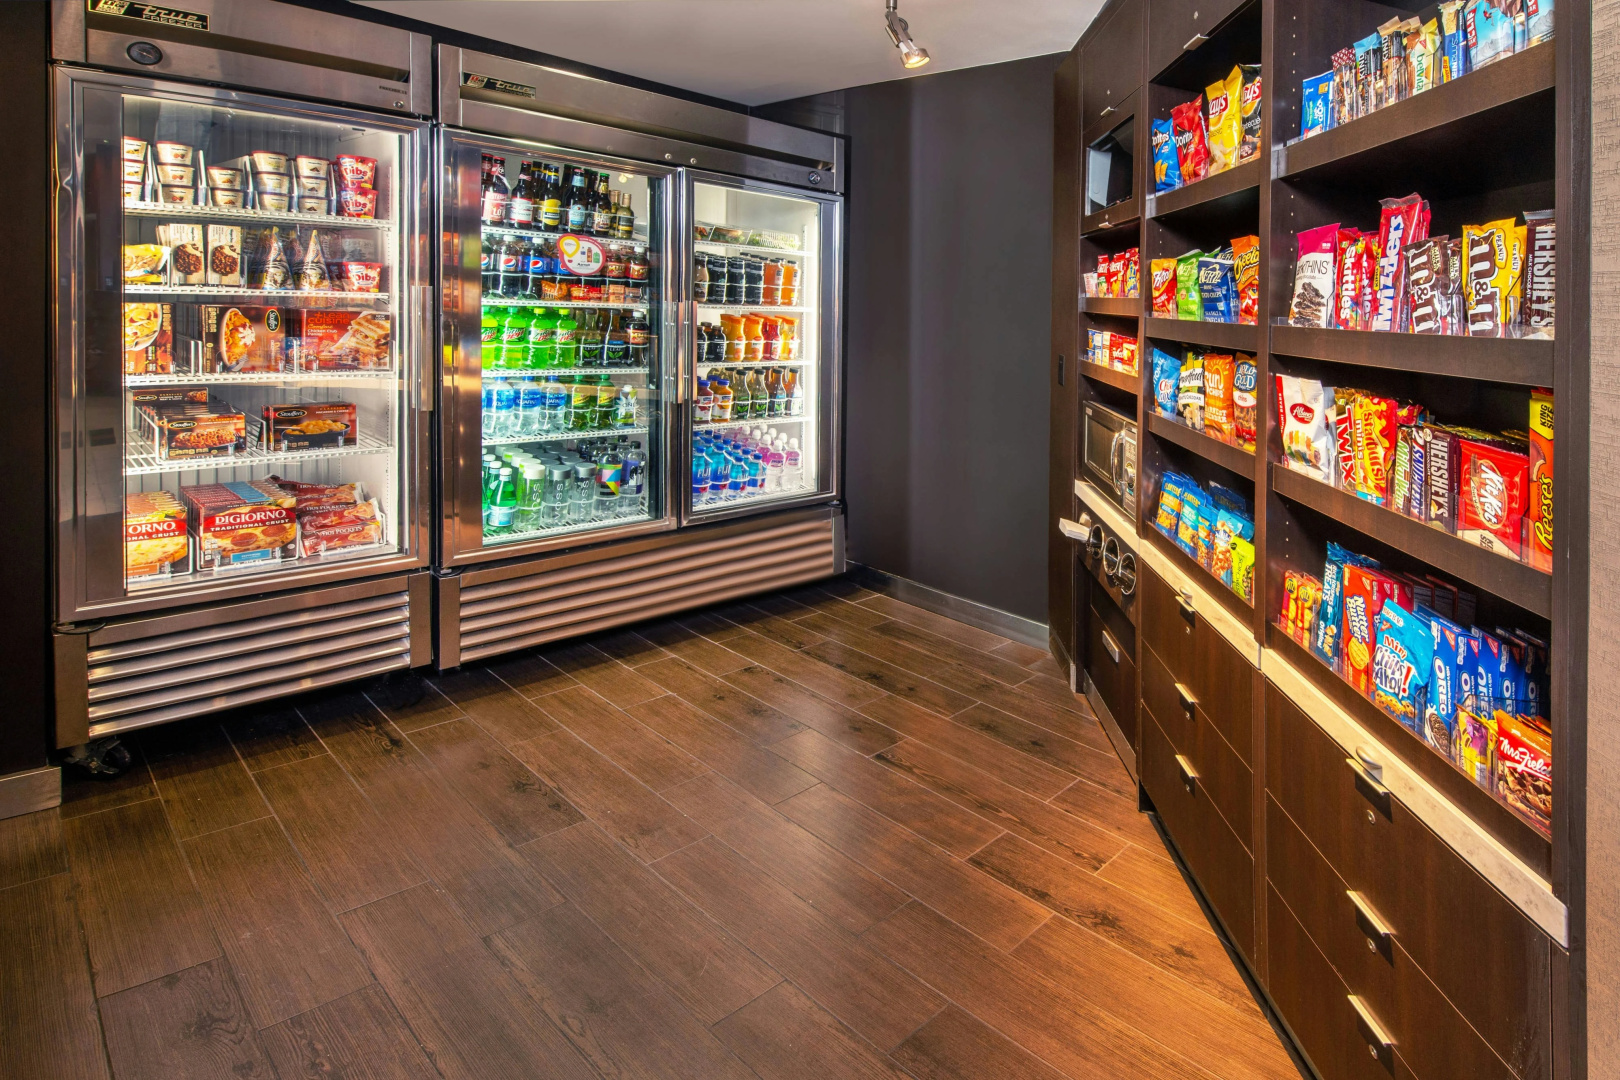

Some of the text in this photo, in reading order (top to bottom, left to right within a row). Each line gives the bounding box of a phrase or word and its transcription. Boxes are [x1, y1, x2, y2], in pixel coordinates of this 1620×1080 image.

[1466, 10, 1476, 38] CLIF
[344, 166, 368, 177] Dibs
[344, 200, 368, 209] Dibs
[1495, 234, 1504, 262] PEANUT
[355, 273, 377, 282] Dibs
[1234, 249, 1259, 281] Cheeto
[1340, 245, 1356, 320] Skittles
[1208, 387, 1224, 398] CHIPS
[1234, 374, 1255, 389] GOLD
[1540, 404, 1548, 427] KING
[1336, 405, 1356, 486] TWIX
[1355, 419, 1364, 461] minis
[1362, 410, 1387, 487] Starburst
[697, 467, 711, 478] FIJI
[717, 464, 731, 475] FIJI
[1411, 445, 1424, 517] SNICKERS
[1431, 438, 1449, 518] HERSHEY'S
[1480, 464, 1504, 496] Kit
[554, 483, 564, 520] VOSS
[580, 480, 589, 519] VOSS
[1480, 488, 1503, 524] Kat
[210, 518, 290, 532] TRADITIONAL CRUST
[215, 509, 287, 525] DIGIORNO
[152, 531, 180, 539] CRUST
[1322, 563, 1331, 601] TREATS
[1346, 597, 1363, 644] Butter
[1353, 595, 1370, 643] Nutter
[1375, 646, 1406, 677] Chips
[1384, 635, 1407, 660] Mini
[1433, 657, 1447, 715] OREO
